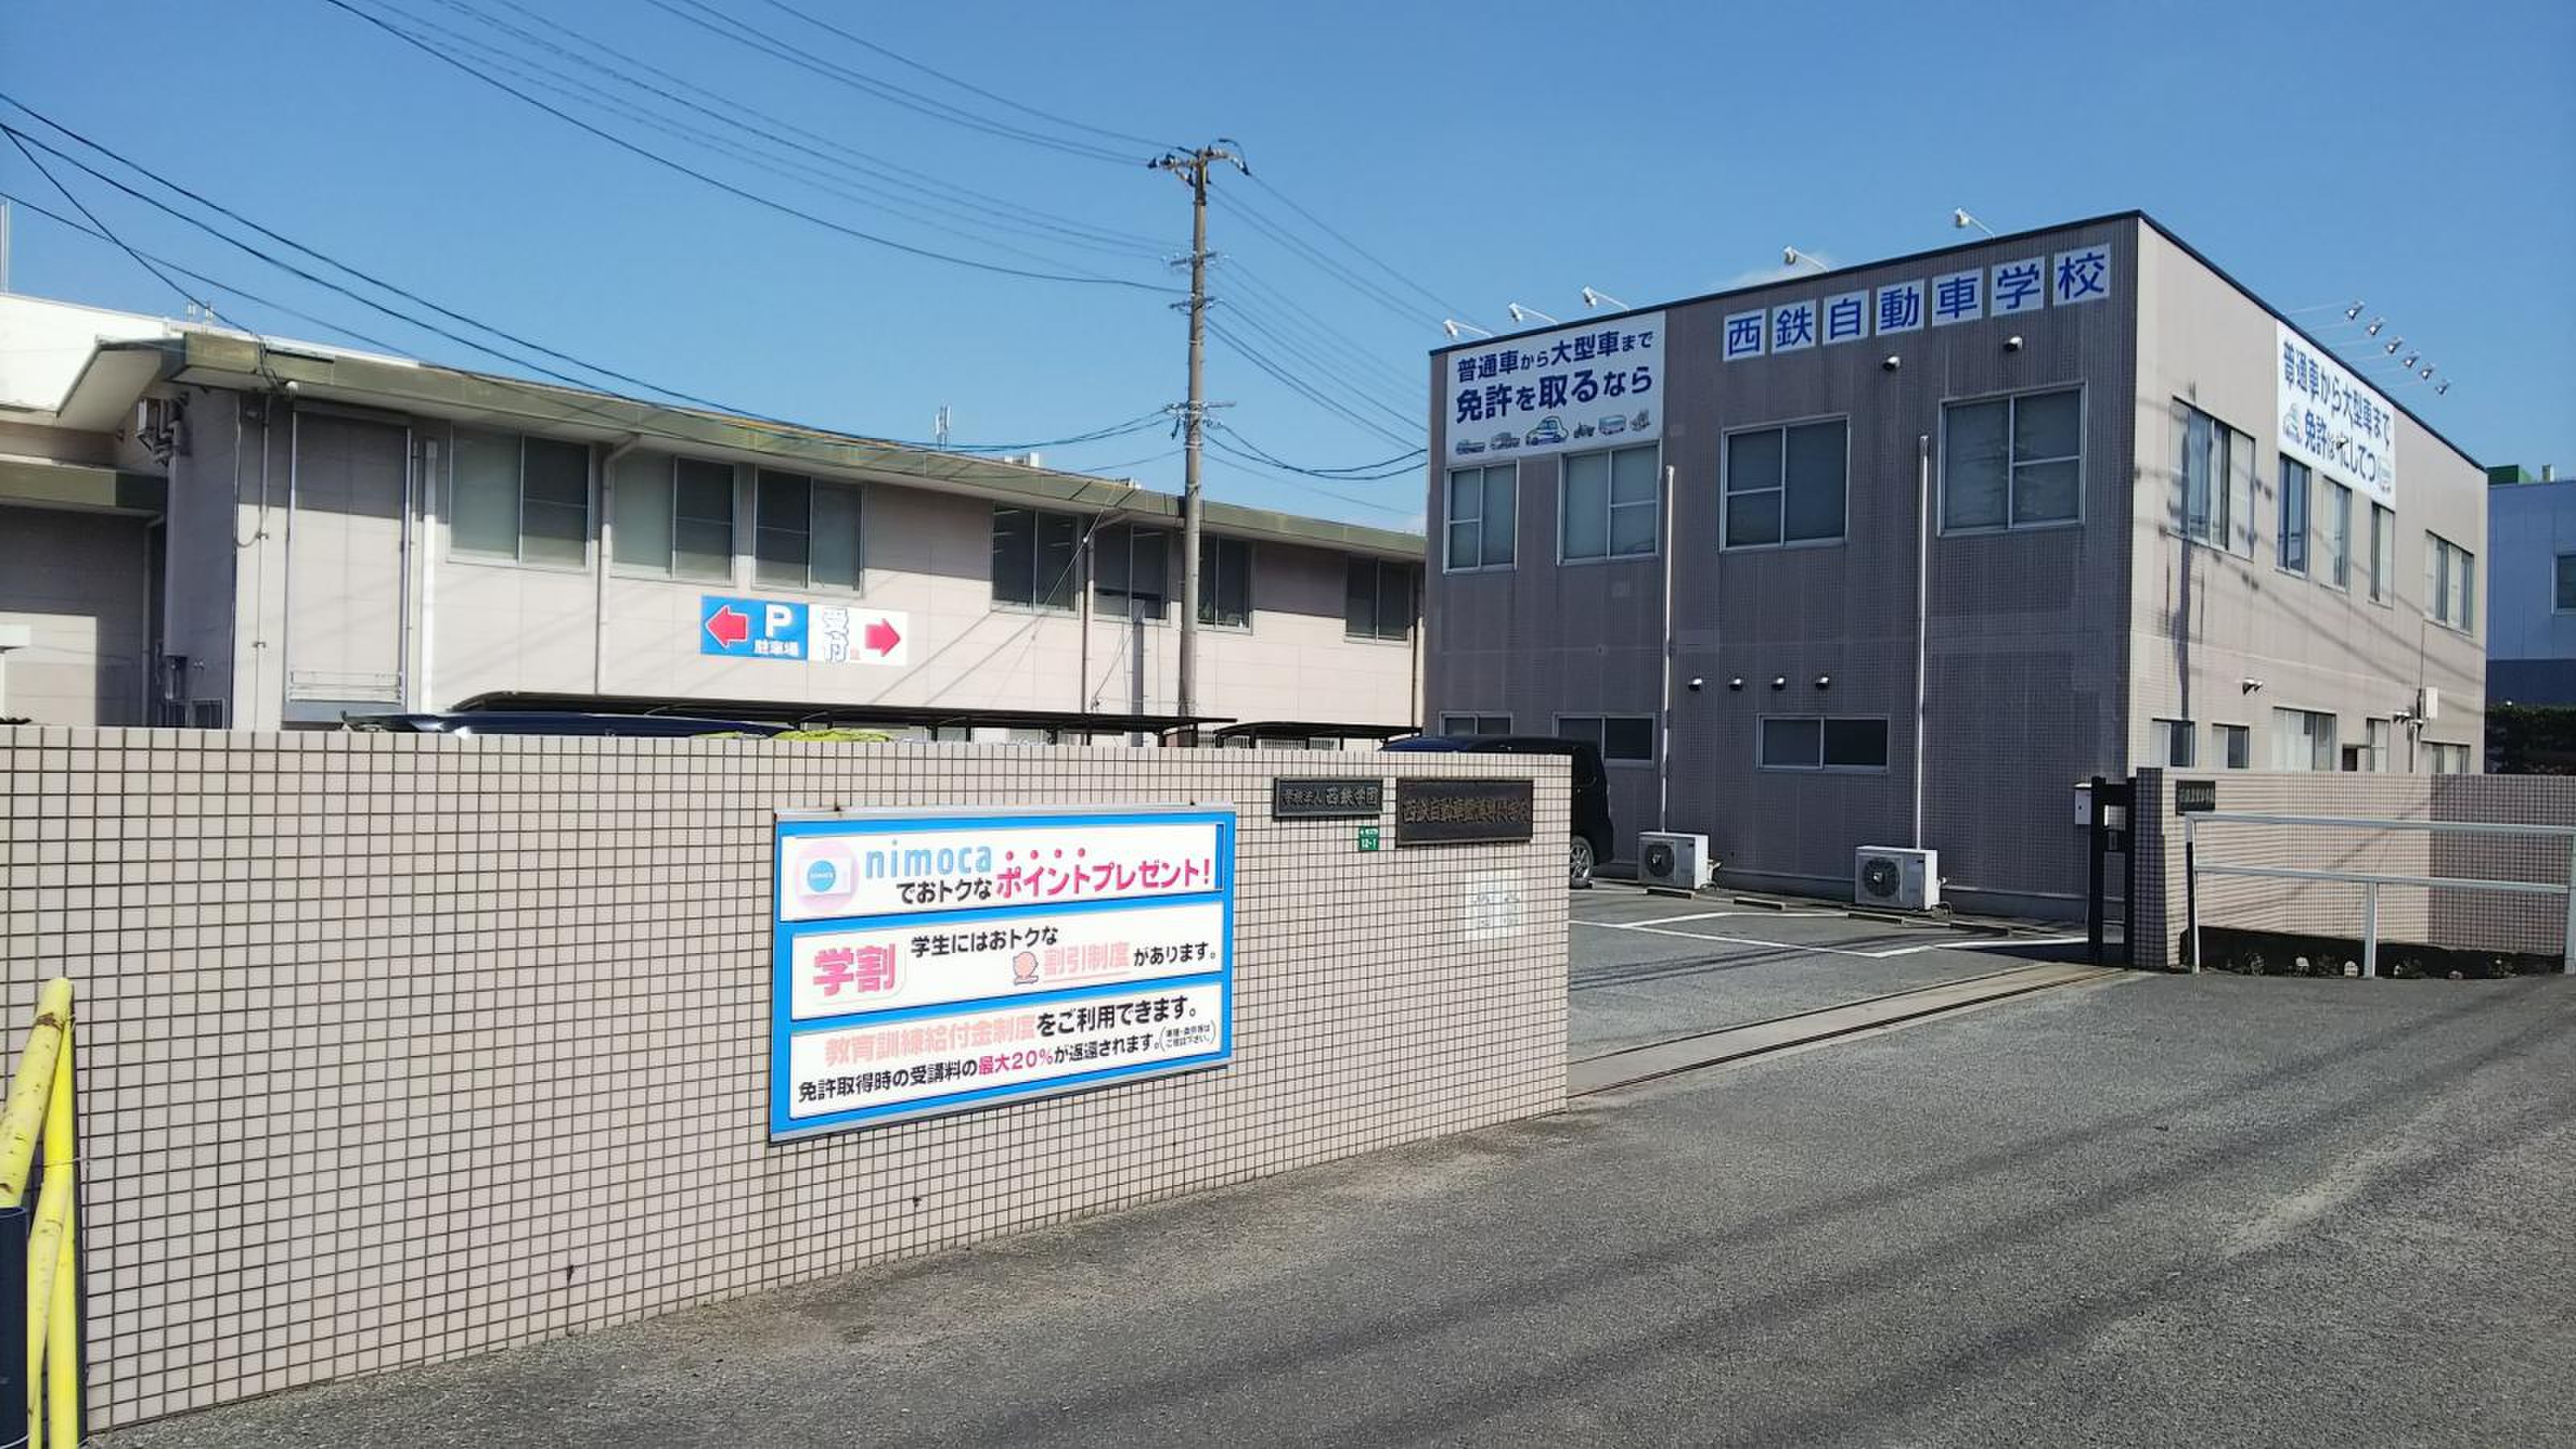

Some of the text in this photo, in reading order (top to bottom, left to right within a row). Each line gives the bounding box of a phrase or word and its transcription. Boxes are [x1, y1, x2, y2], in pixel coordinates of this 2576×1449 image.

[1728, 252, 2106, 356] 西鉄自動車学校
[1457, 330, 1653, 382] 普通車から大型車まで
[1455, 365, 1653, 424] 免許を取るなら
[765, 605, 792, 638] P
[865, 840, 992, 879] nimoca
[910, 926, 1059, 957] 学生にはおトクな
[812, 943, 896, 997] 学割
